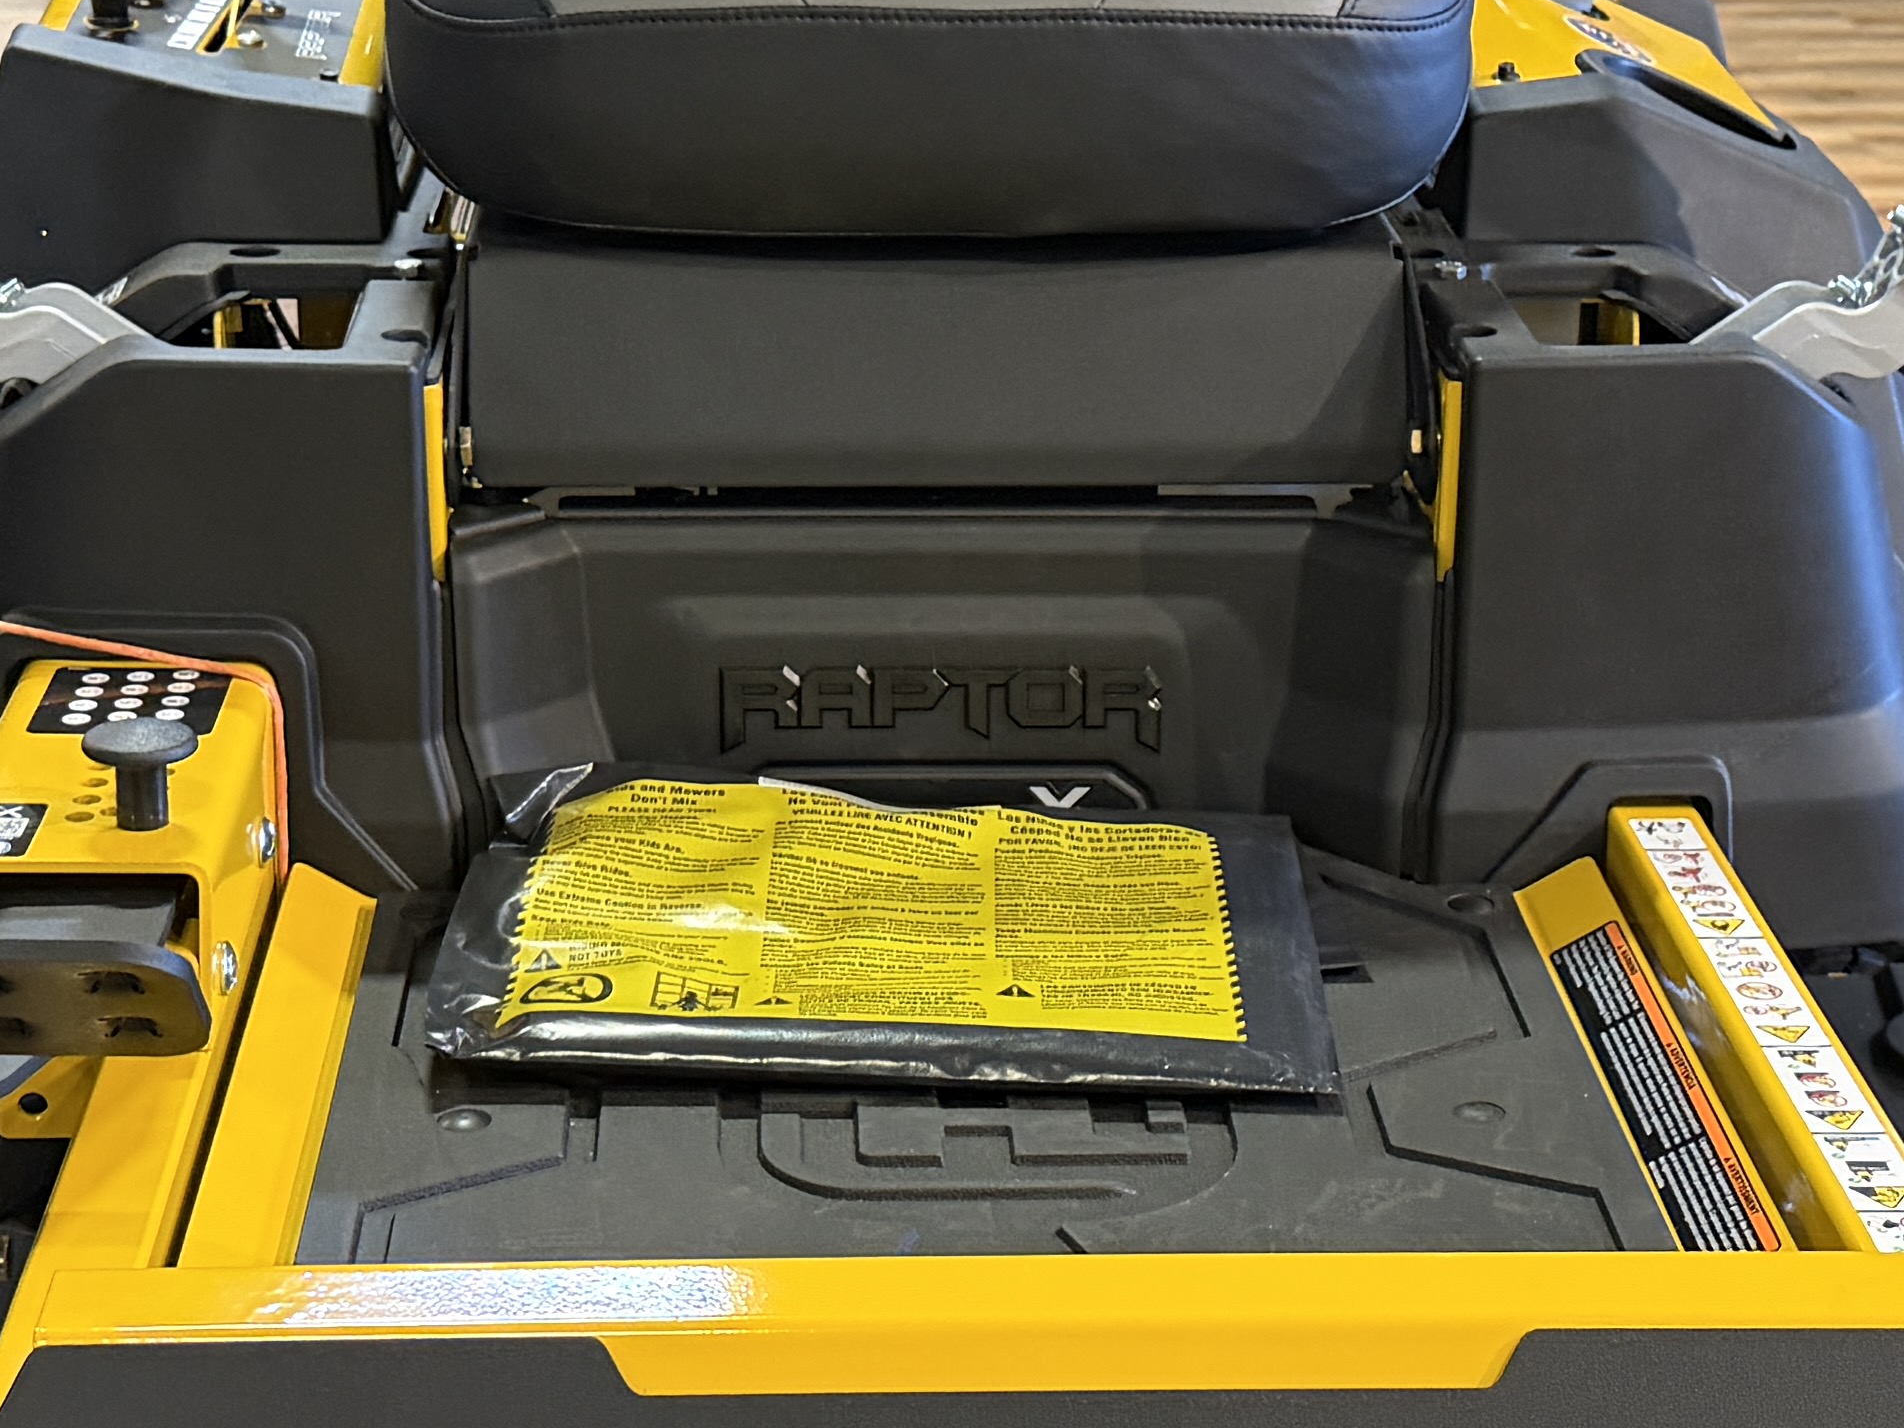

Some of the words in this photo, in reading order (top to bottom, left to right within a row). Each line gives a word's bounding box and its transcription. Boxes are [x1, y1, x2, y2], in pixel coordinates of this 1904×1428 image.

[720, 666, 1161, 754] RAPTOR
[630, 793, 668, 805] Don't
[905, 817, 965, 838] ATTENTION
